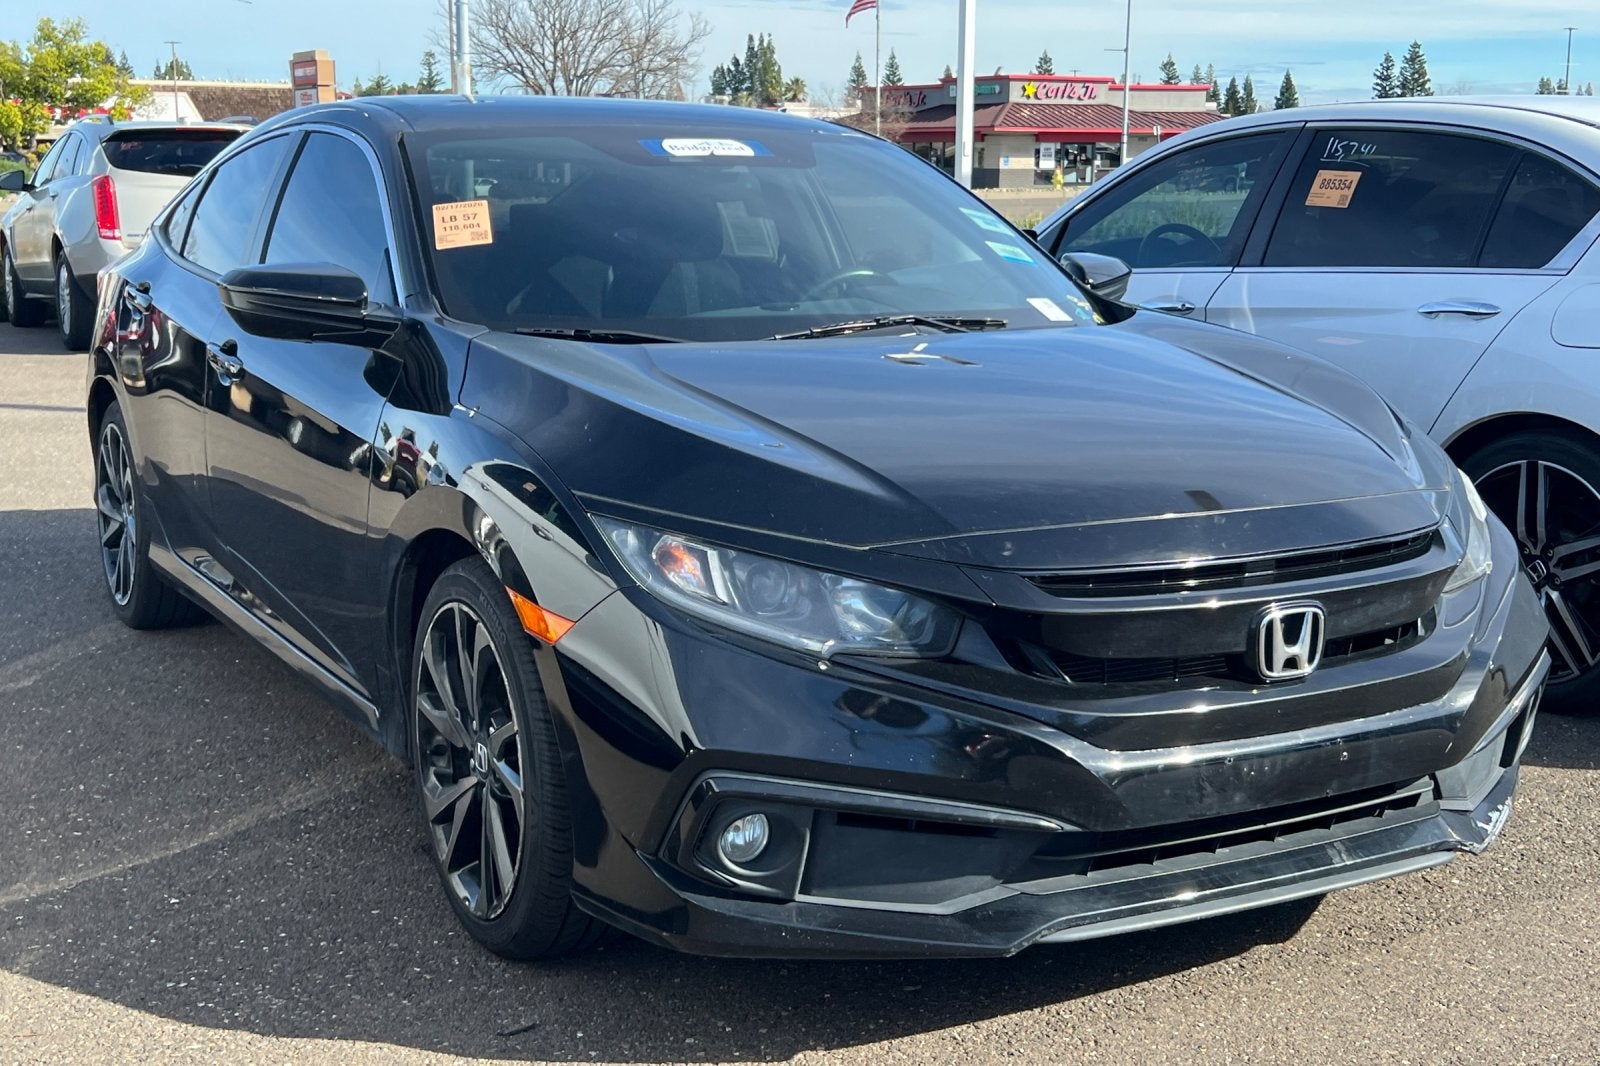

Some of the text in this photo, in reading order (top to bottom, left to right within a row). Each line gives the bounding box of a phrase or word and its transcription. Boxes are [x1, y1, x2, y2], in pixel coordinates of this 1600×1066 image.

[1036, 81, 1079, 99] Carl's
[1323, 136, 1377, 162] 115,741
[1319, 178, 1354, 191] 885354
[441, 212, 478, 224] LB 57
